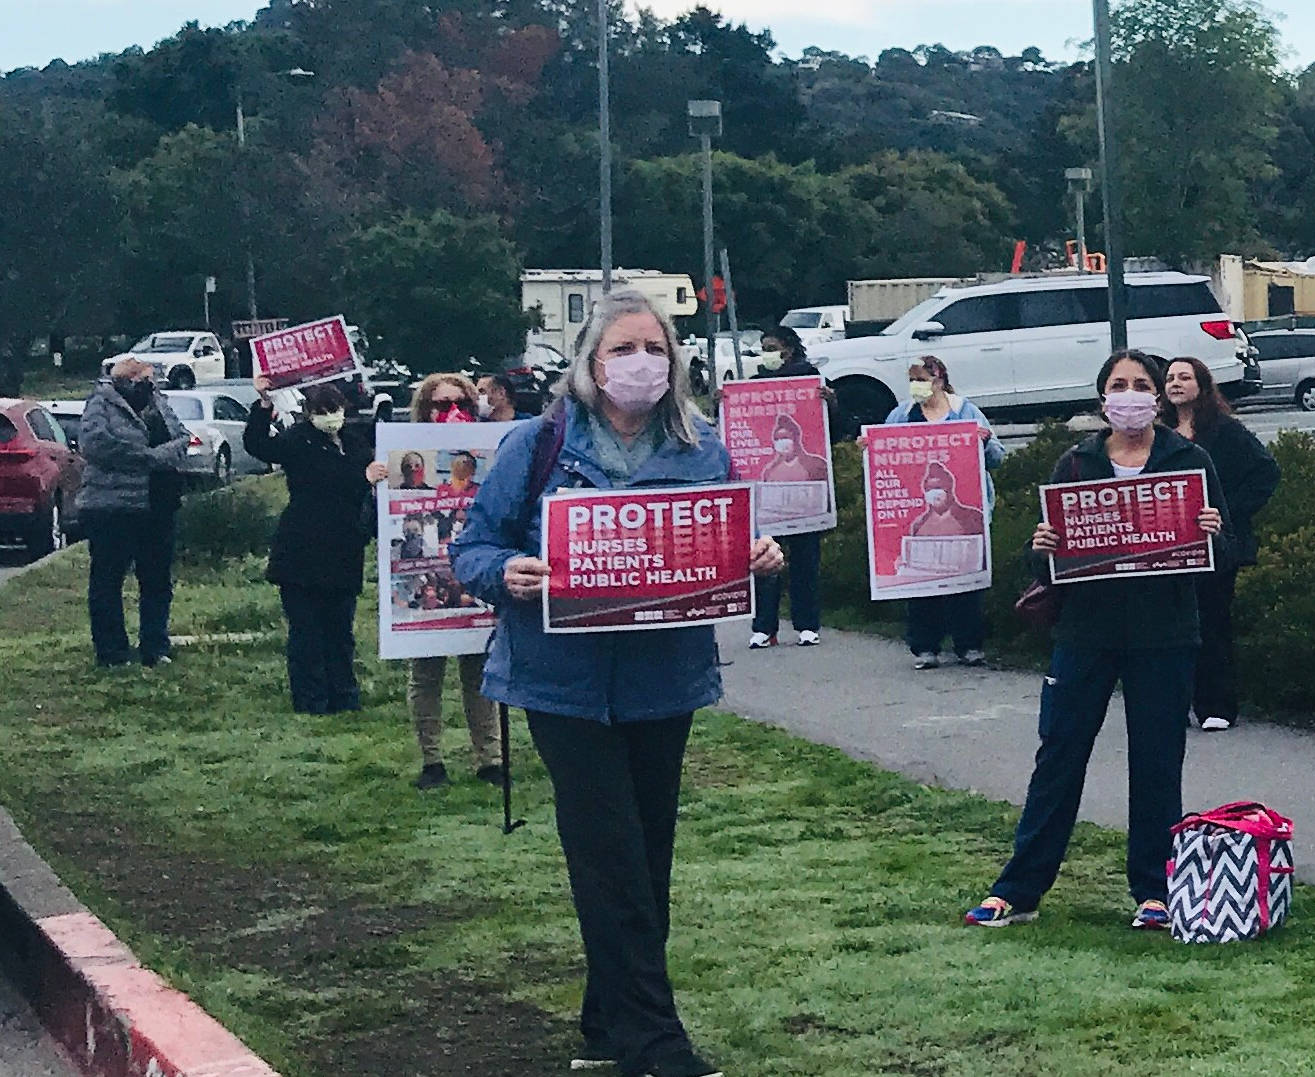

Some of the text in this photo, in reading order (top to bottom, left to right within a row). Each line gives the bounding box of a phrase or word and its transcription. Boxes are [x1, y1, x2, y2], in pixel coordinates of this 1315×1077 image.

[263, 323, 335, 354] PROTECT
[729, 388, 817, 406] #PROTECT
[729, 403, 797, 419] NURSES
[729, 421, 750, 430] ALL
[730, 430, 753, 440] OUR
[874, 433, 972, 451] #PROTECT
[874, 450, 950, 466] NURSES
[875, 469, 898, 479] ALL
[875, 479, 901, 489] OUR
[876, 488, 910, 499] LIVES
[1061, 479, 1189, 511] PROTECT
[876, 498, 925, 510] DEPEND
[568, 497, 734, 534] PROTECT
[877, 509, 910, 520] ON IT
[1065, 511, 1121, 526] NURSES
[1066, 521, 1135, 538] PATIENTS
[569, 538, 649, 556] NURSES
[1067, 530, 1177, 550] PUBLIC HEALTH
[569, 553, 665, 572] PATIENTS
[569, 566, 718, 589] PUBLIC HEALTH
